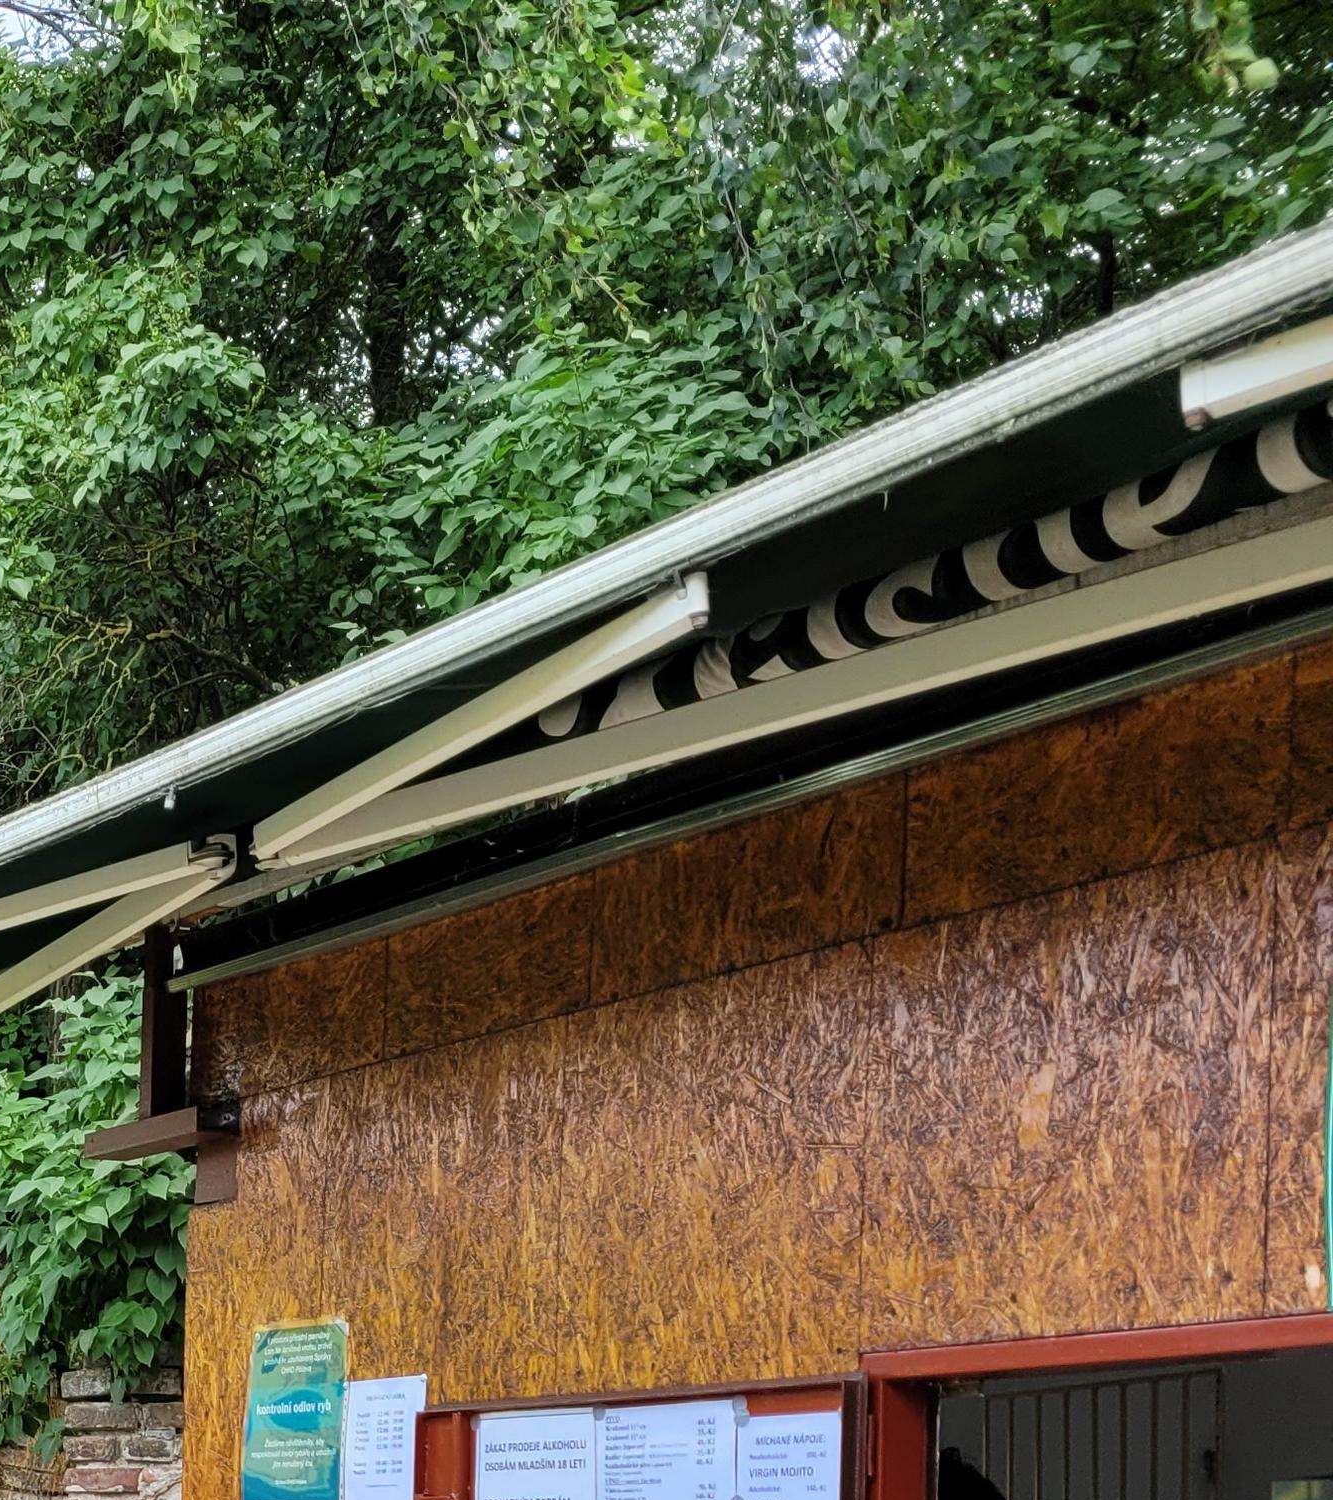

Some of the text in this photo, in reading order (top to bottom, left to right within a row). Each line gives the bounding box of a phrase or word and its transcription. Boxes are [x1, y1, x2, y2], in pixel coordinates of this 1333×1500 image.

[256, 1398, 331, 1416] kontrolní odlov ryb
[485, 1439, 587, 1454] ZÁKAZ PRODEJE ALKOHOLU
[755, 1433, 827, 1446] MÍCHANÉ NÁPOJE:
[485, 1459, 517, 1472] OSOBÁM
[518, 1457, 556, 1471] MLADŠÍM
[557, 1459, 568, 1470] 18
[749, 1466, 814, 1478] VIRGIN MOJITO
